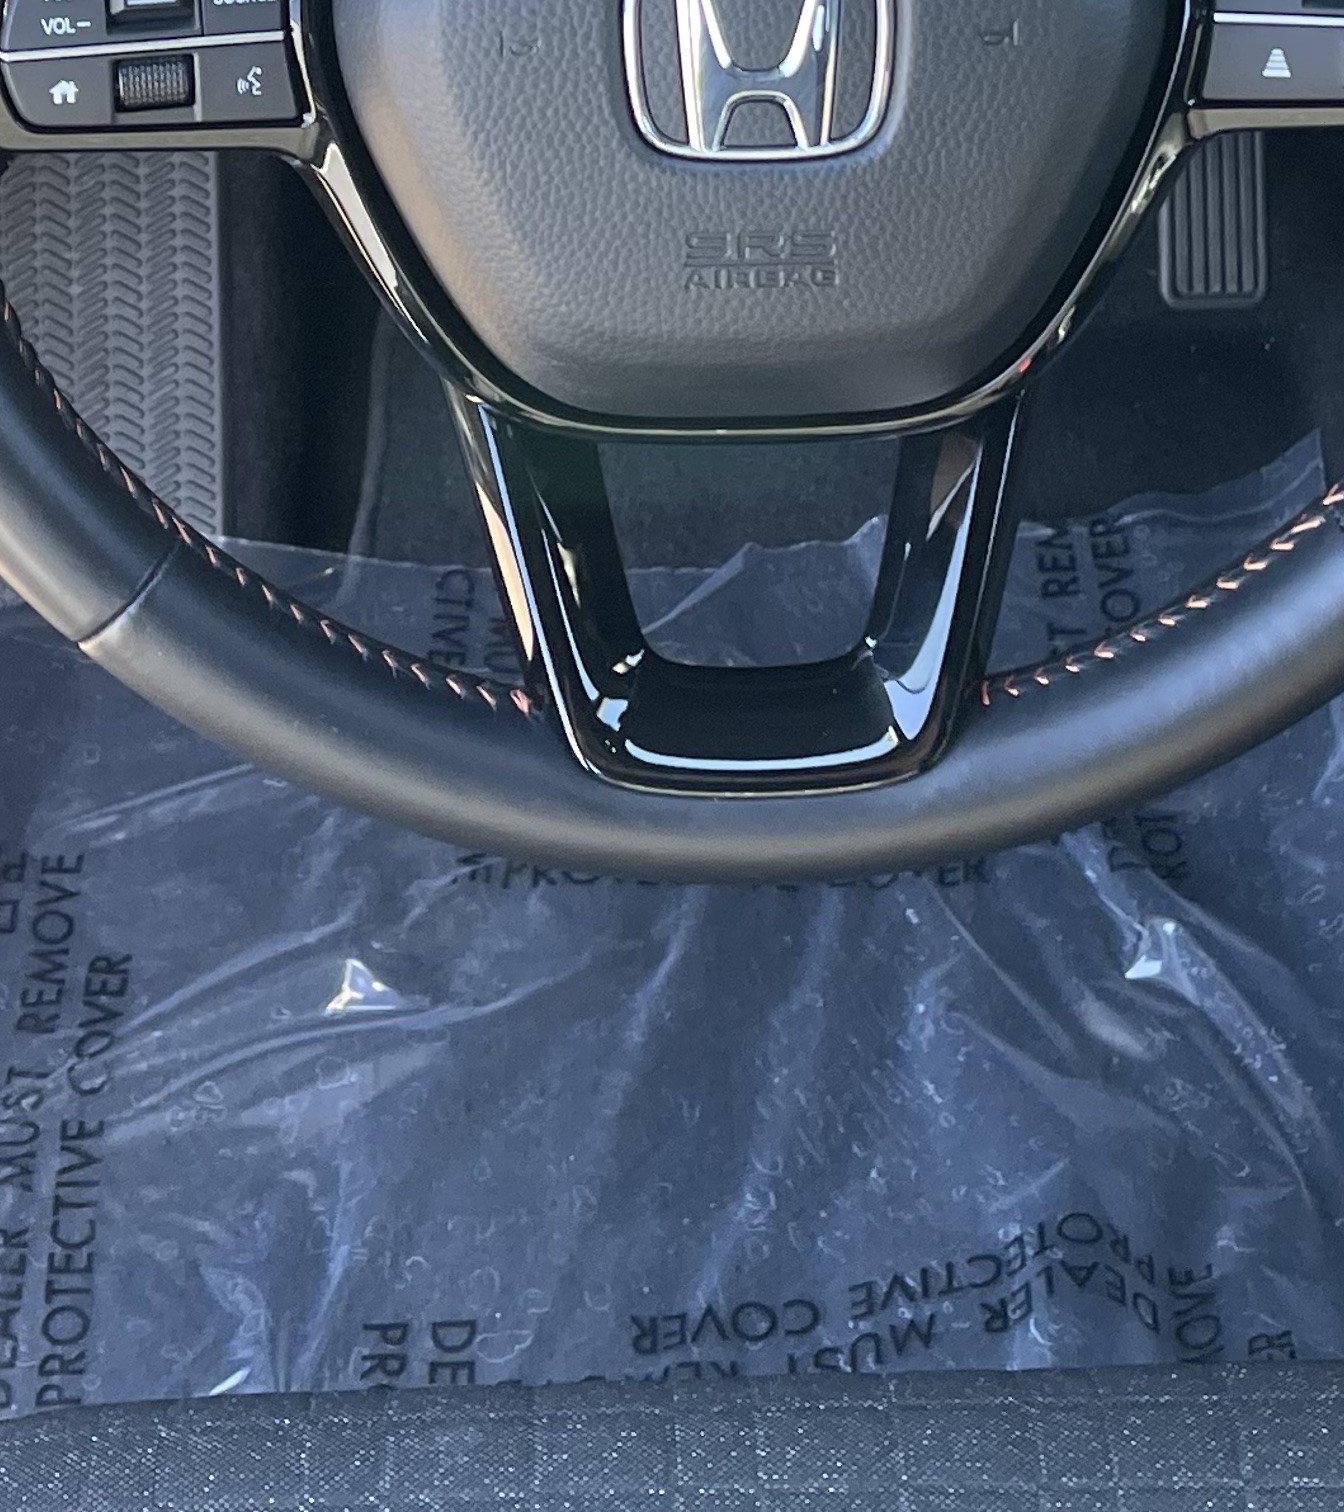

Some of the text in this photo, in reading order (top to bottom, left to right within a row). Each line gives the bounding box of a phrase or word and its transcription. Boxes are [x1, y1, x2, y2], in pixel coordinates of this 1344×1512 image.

[684, 231, 837, 260] SRS
[683, 268, 841, 290] AIRBAG
[15, 852, 84, 1034] REMOVE
[35, 951, 133, 1407] PROTECTIVE COVER
[630, 1298, 821, 1357] COVER
